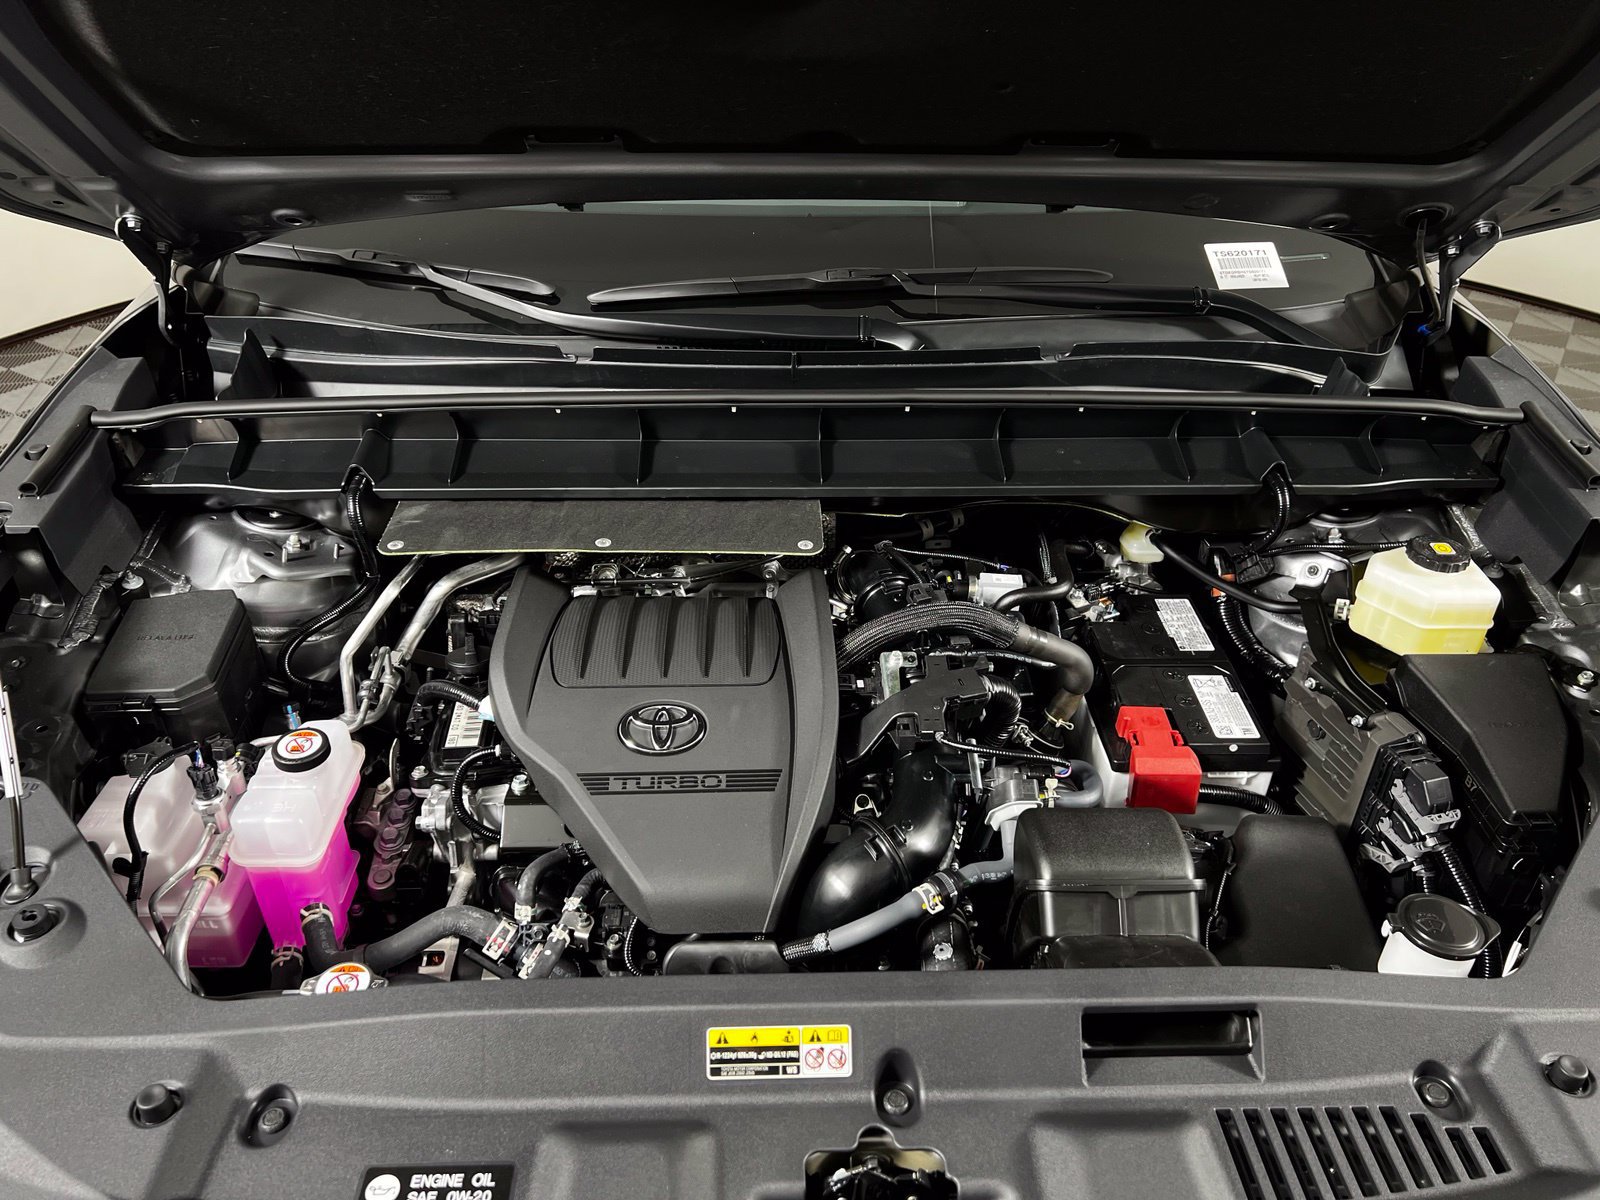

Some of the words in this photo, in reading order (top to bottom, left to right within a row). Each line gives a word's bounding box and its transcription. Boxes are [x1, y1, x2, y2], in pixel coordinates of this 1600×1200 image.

[1212, 249, 1267, 257] TS620171
[613, 774, 723, 790] TURBO
[410, 1173, 465, 1189] ENGINE
[471, 1172, 496, 1188] OIL
[406, 1190, 438, 1200] SAE
[445, 1189, 493, 1200] 0W-20
